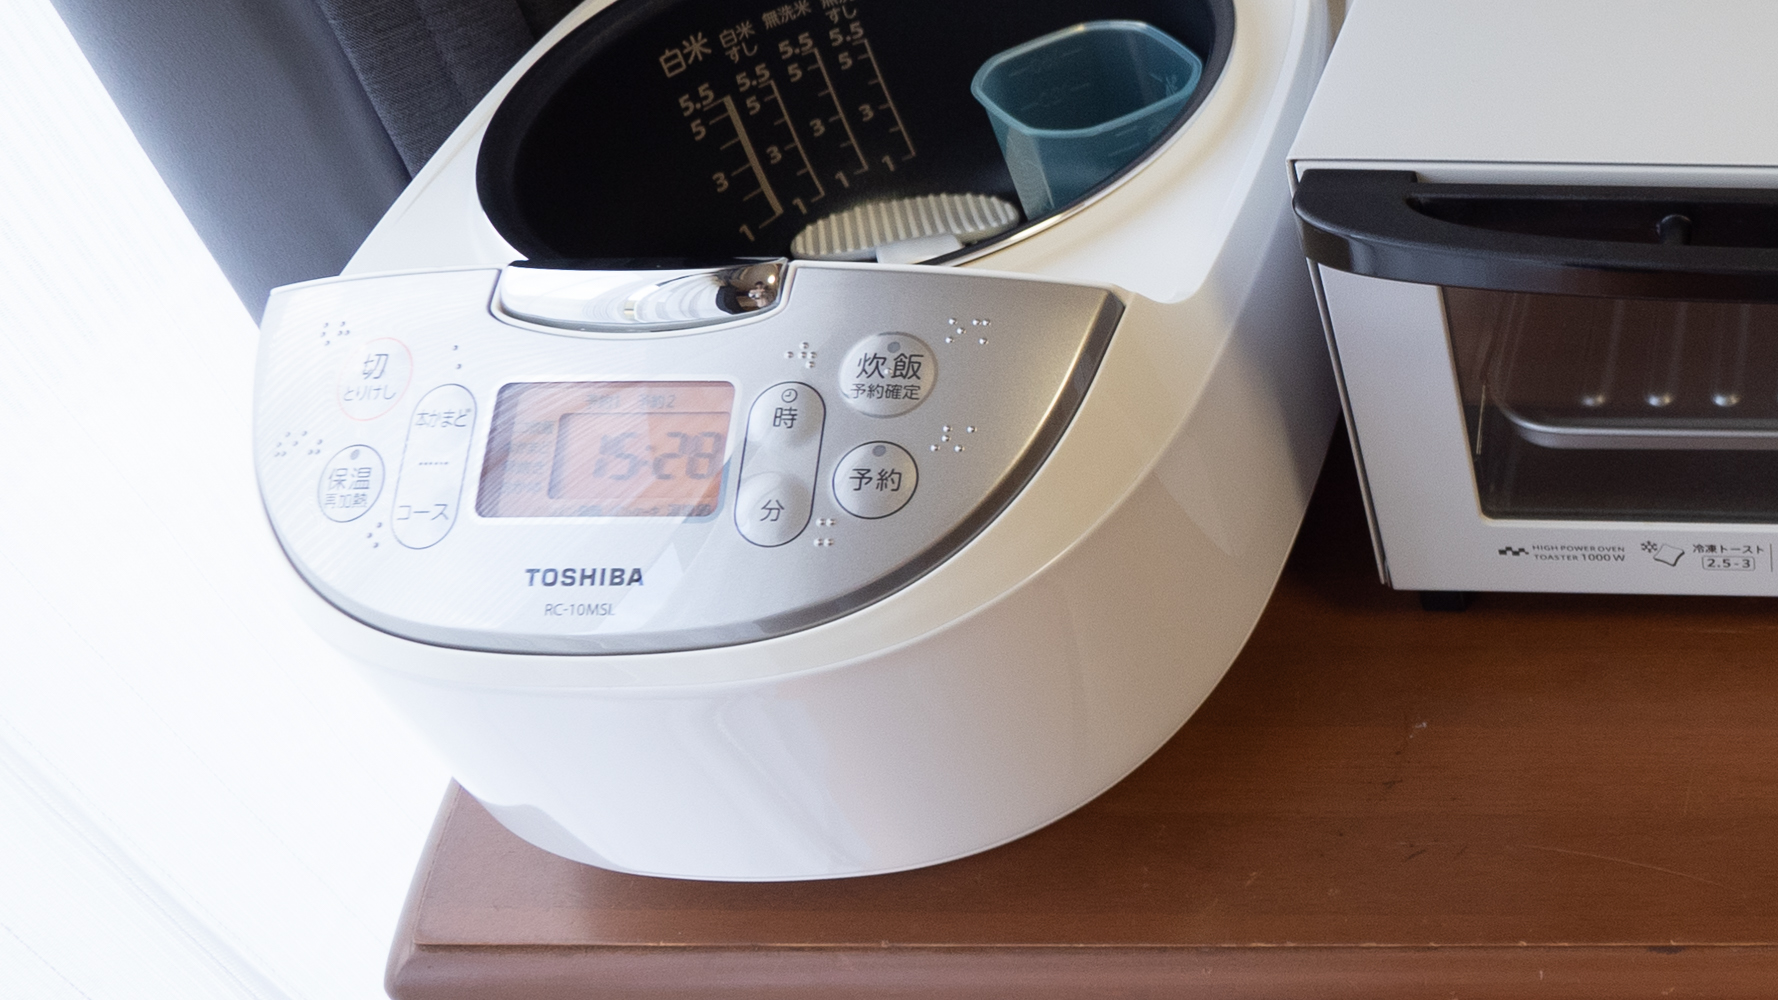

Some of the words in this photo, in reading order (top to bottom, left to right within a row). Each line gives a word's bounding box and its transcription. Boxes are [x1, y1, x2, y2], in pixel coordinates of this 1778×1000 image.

[761, 0, 811, 29] 無洗米
[825, 3, 858, 24] すし
[719, 20, 755, 50] 白米
[829, 20, 864, 47] 5.5
[658, 31, 712, 79] 白米
[725, 41, 758, 65] すし
[778, 32, 814, 60] 5.5
[838, 51, 853, 71] 5
[736, 63, 771, 92] 5.5
[788, 63, 803, 83] 5
[678, 83, 715, 117] 5.5
[746, 96, 761, 116] 5
[858, 104, 875, 122] 3
[690, 120, 706, 141] 5
[810, 118, 826, 137] 3
[766, 145, 783, 164] 3
[882, 155, 896, 173] 1
[712, 171, 729, 193] 3
[835, 170, 849, 188] 1
[792, 197, 808, 215] 1
[739, 223, 755, 242] 1
[362, 353, 389, 381] 切
[855, 353, 924, 381] 炊飯
[343, 386, 397, 402] とりけし
[849, 383, 922, 401] 予約確定
[772, 407, 798, 429] 時
[327, 467, 373, 491] 保温
[848, 468, 903, 492] 予約
[397, 503, 449, 521] コース
[760, 500, 785, 522] 分
[1692, 544, 1764, 555] 冷凍トースト
[525, 567, 644, 587] TOSHIBA
[544, 603, 616, 617] RC-10MSL
